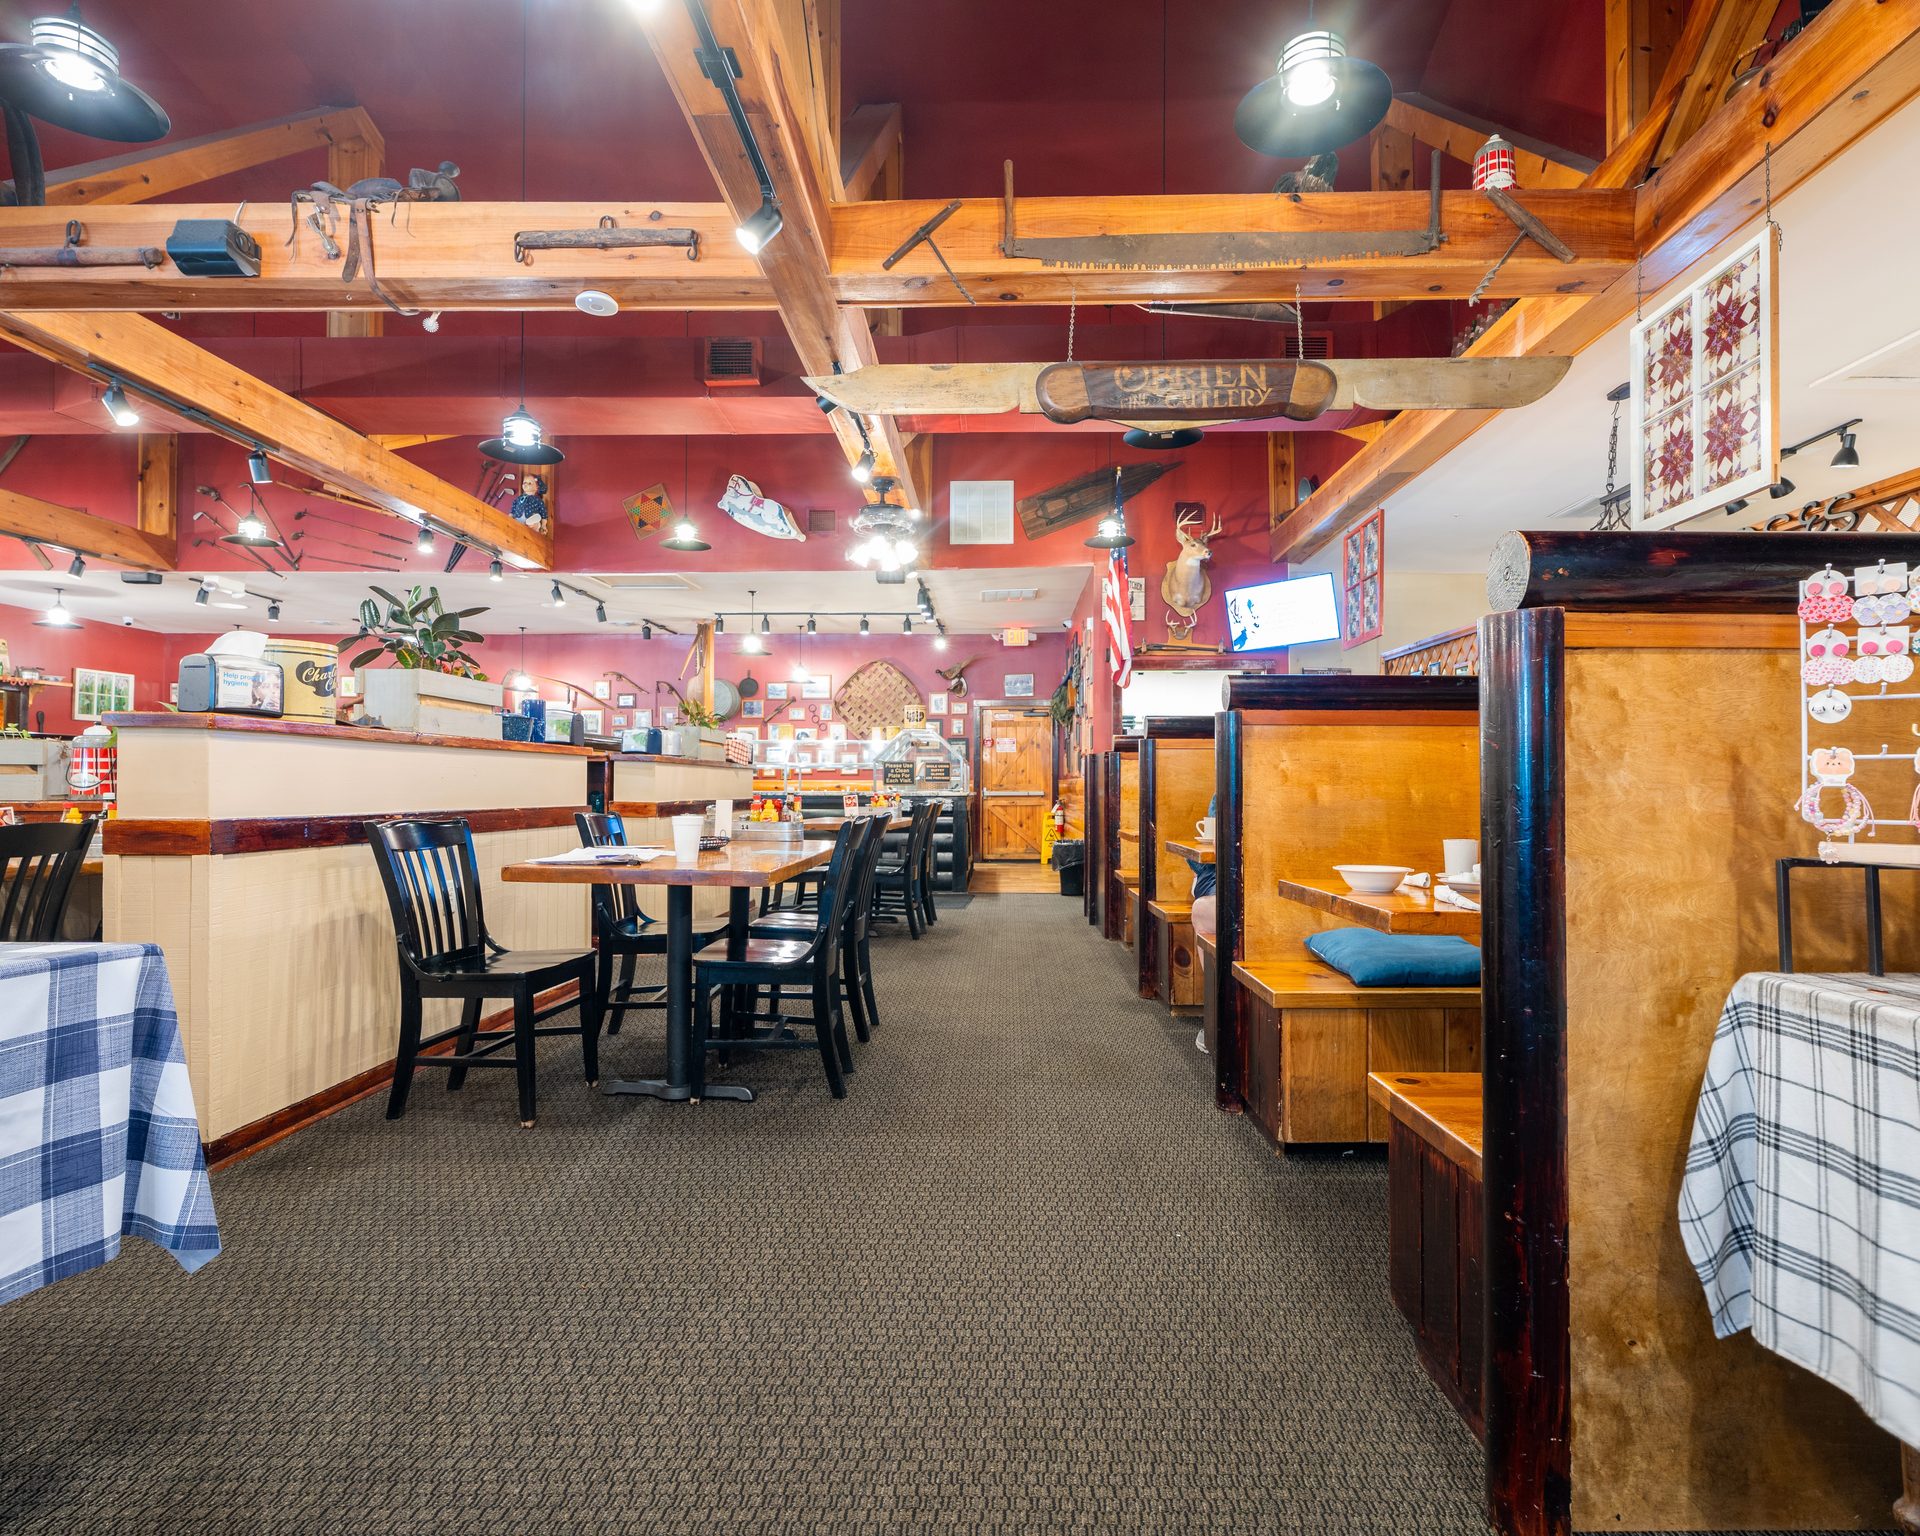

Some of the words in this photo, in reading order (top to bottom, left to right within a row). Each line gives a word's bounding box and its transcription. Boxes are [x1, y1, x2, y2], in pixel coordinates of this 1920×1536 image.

[1007, 630, 1025, 643] EXIT
[223, 672, 239, 680] Help
[223, 679, 249, 687] hygiene
